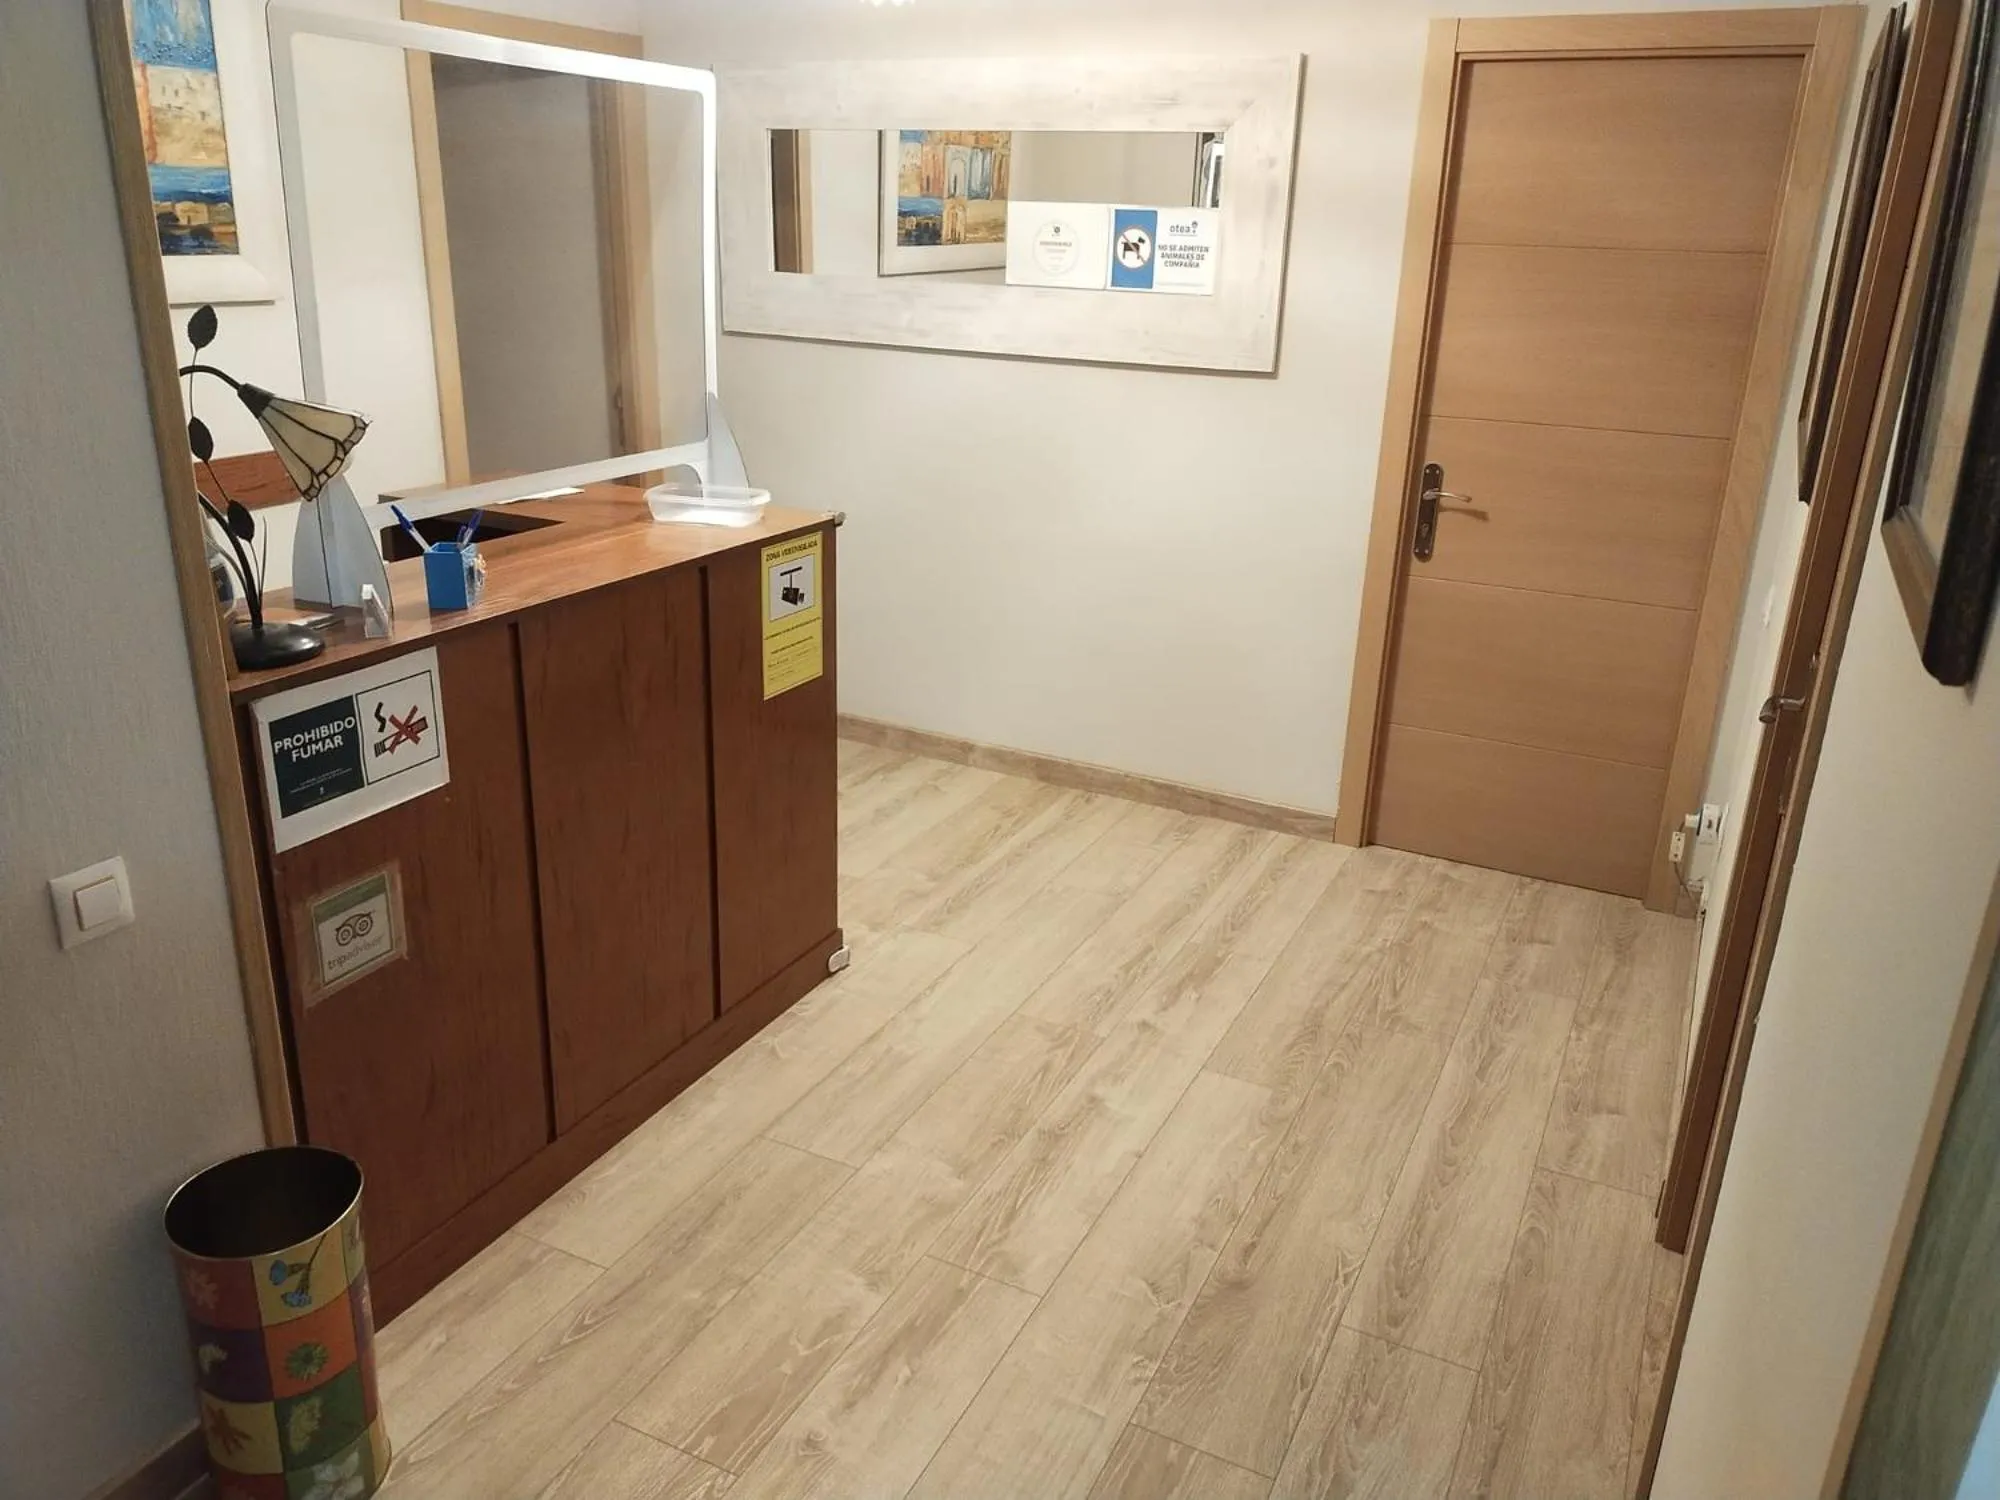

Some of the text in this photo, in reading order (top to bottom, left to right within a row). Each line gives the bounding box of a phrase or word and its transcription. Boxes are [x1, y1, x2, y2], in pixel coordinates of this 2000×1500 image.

[1158, 244, 1168, 252] NO
[1169, 244, 1177, 252] SE
[1160, 252, 1205, 261] ANIMALES DE
[766, 540, 818, 562] ZONA VIDEOVIGILADA
[274, 716, 356, 754] PROHIBIDO
[291, 735, 344, 763] FUMAR
